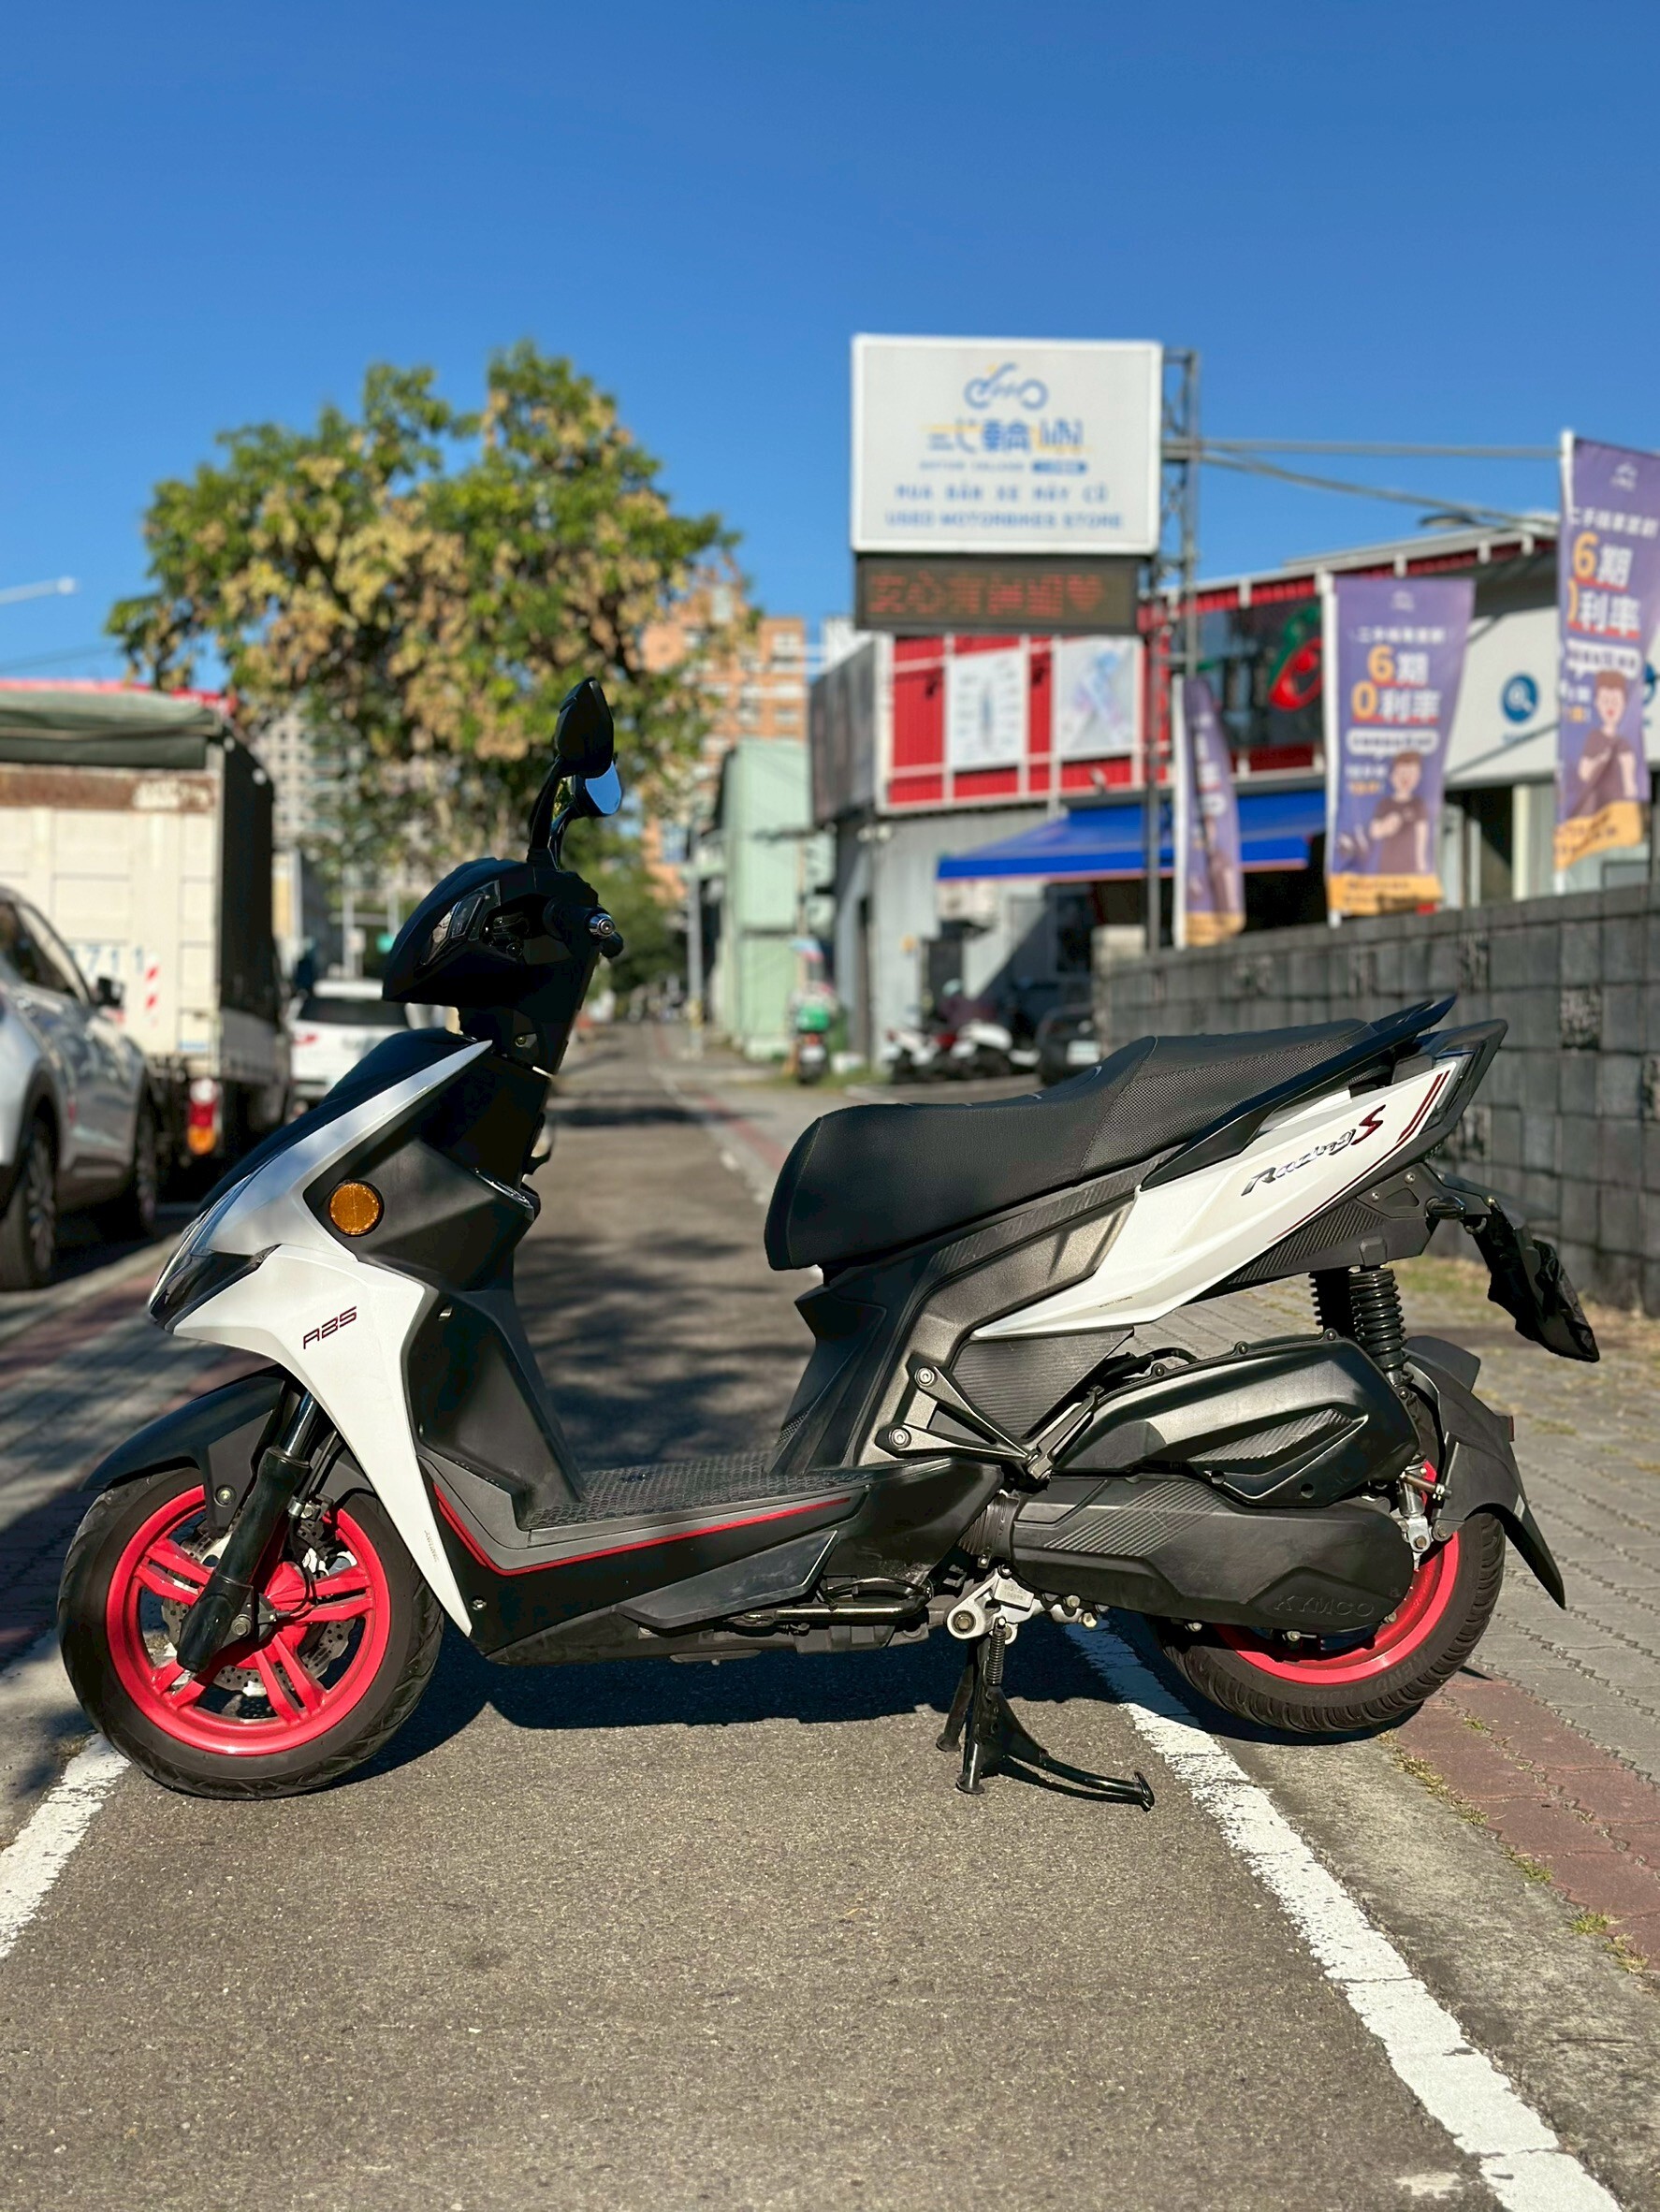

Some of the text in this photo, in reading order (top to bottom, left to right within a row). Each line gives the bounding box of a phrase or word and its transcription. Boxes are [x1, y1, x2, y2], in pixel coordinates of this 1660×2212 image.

[1241, 1104, 1387, 1197] Racing S
[302, 1305, 357, 1350] ABS
[1274, 1594, 1375, 1618] KYMCO
